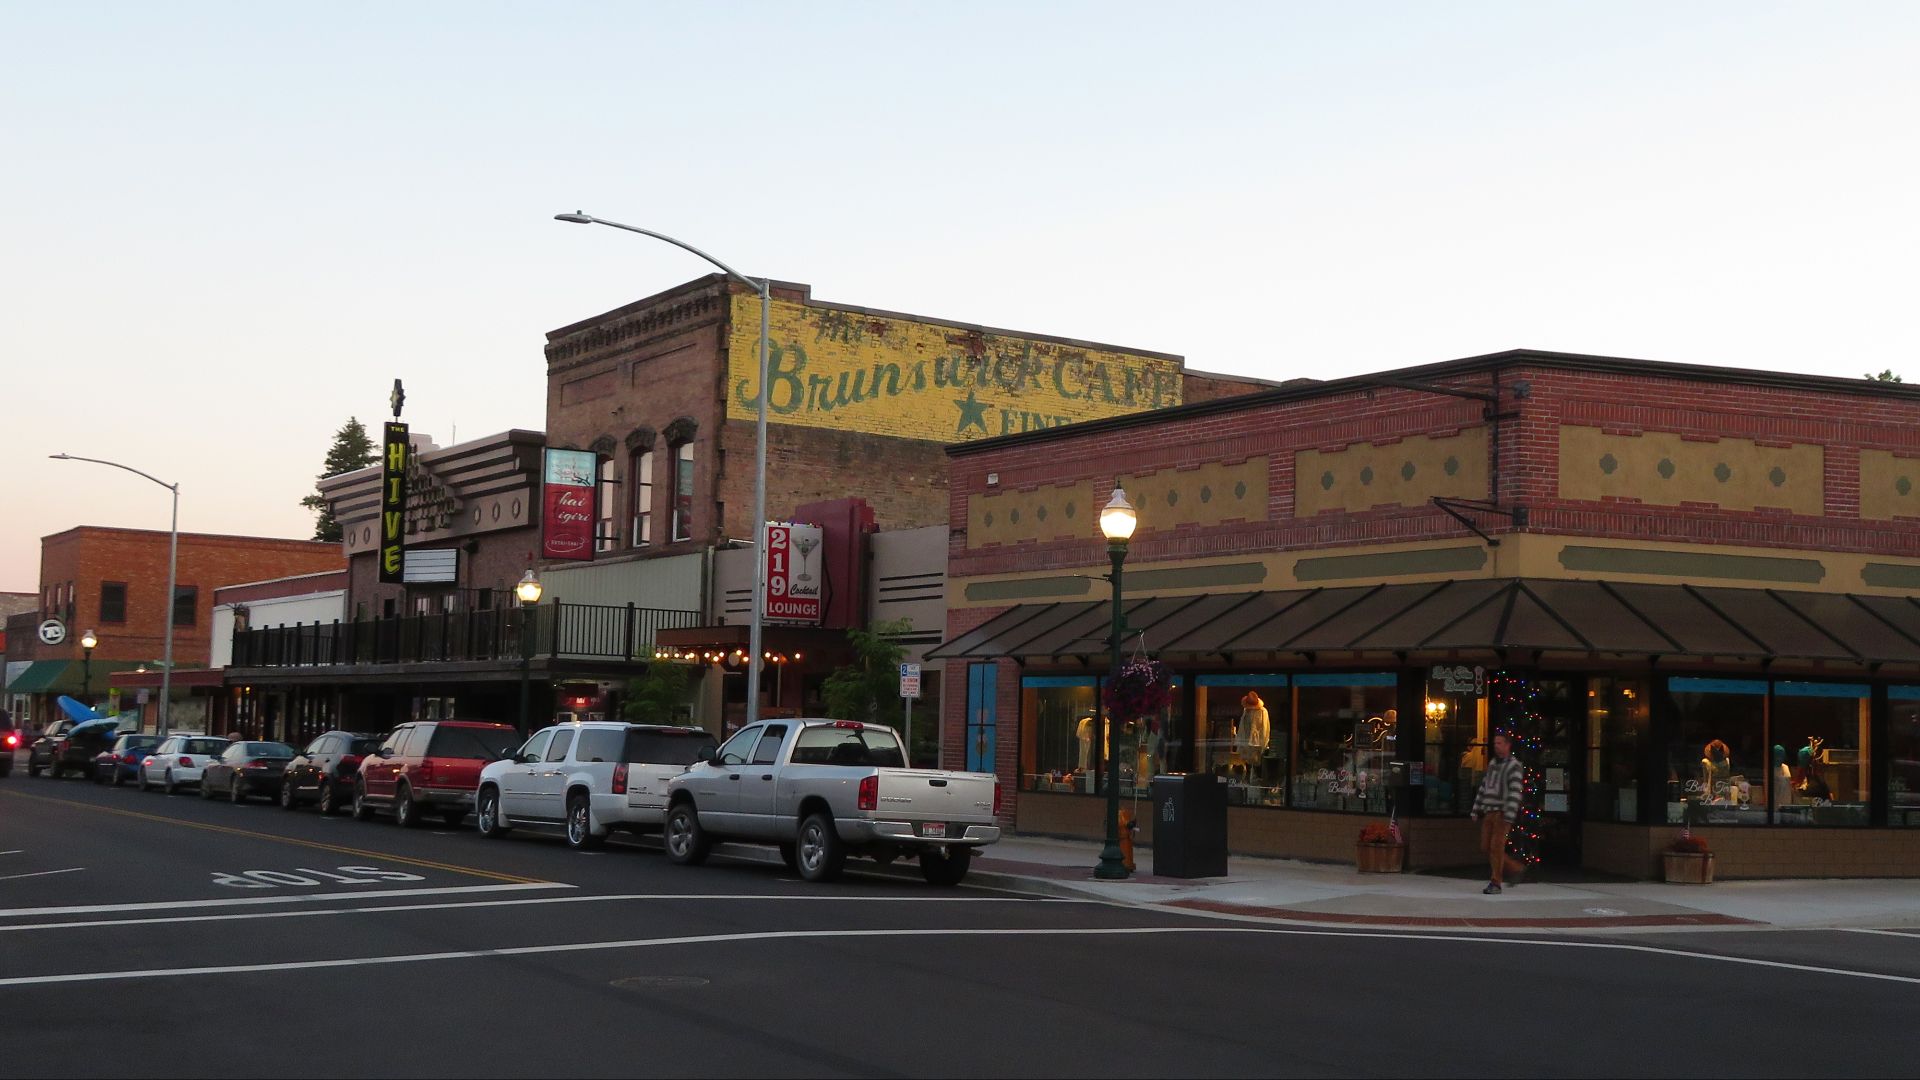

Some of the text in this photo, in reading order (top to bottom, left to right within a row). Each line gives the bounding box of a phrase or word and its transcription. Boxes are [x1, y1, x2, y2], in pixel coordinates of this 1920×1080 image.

[736, 336, 1043, 415] Brunswick
[385, 443, 405, 574] HIVE
[771, 529, 786, 596] 219
[768, 602, 816, 615] LOUNGE
[790, 584, 818, 595] Cocktail
[211, 866, 426, 888] STOP
